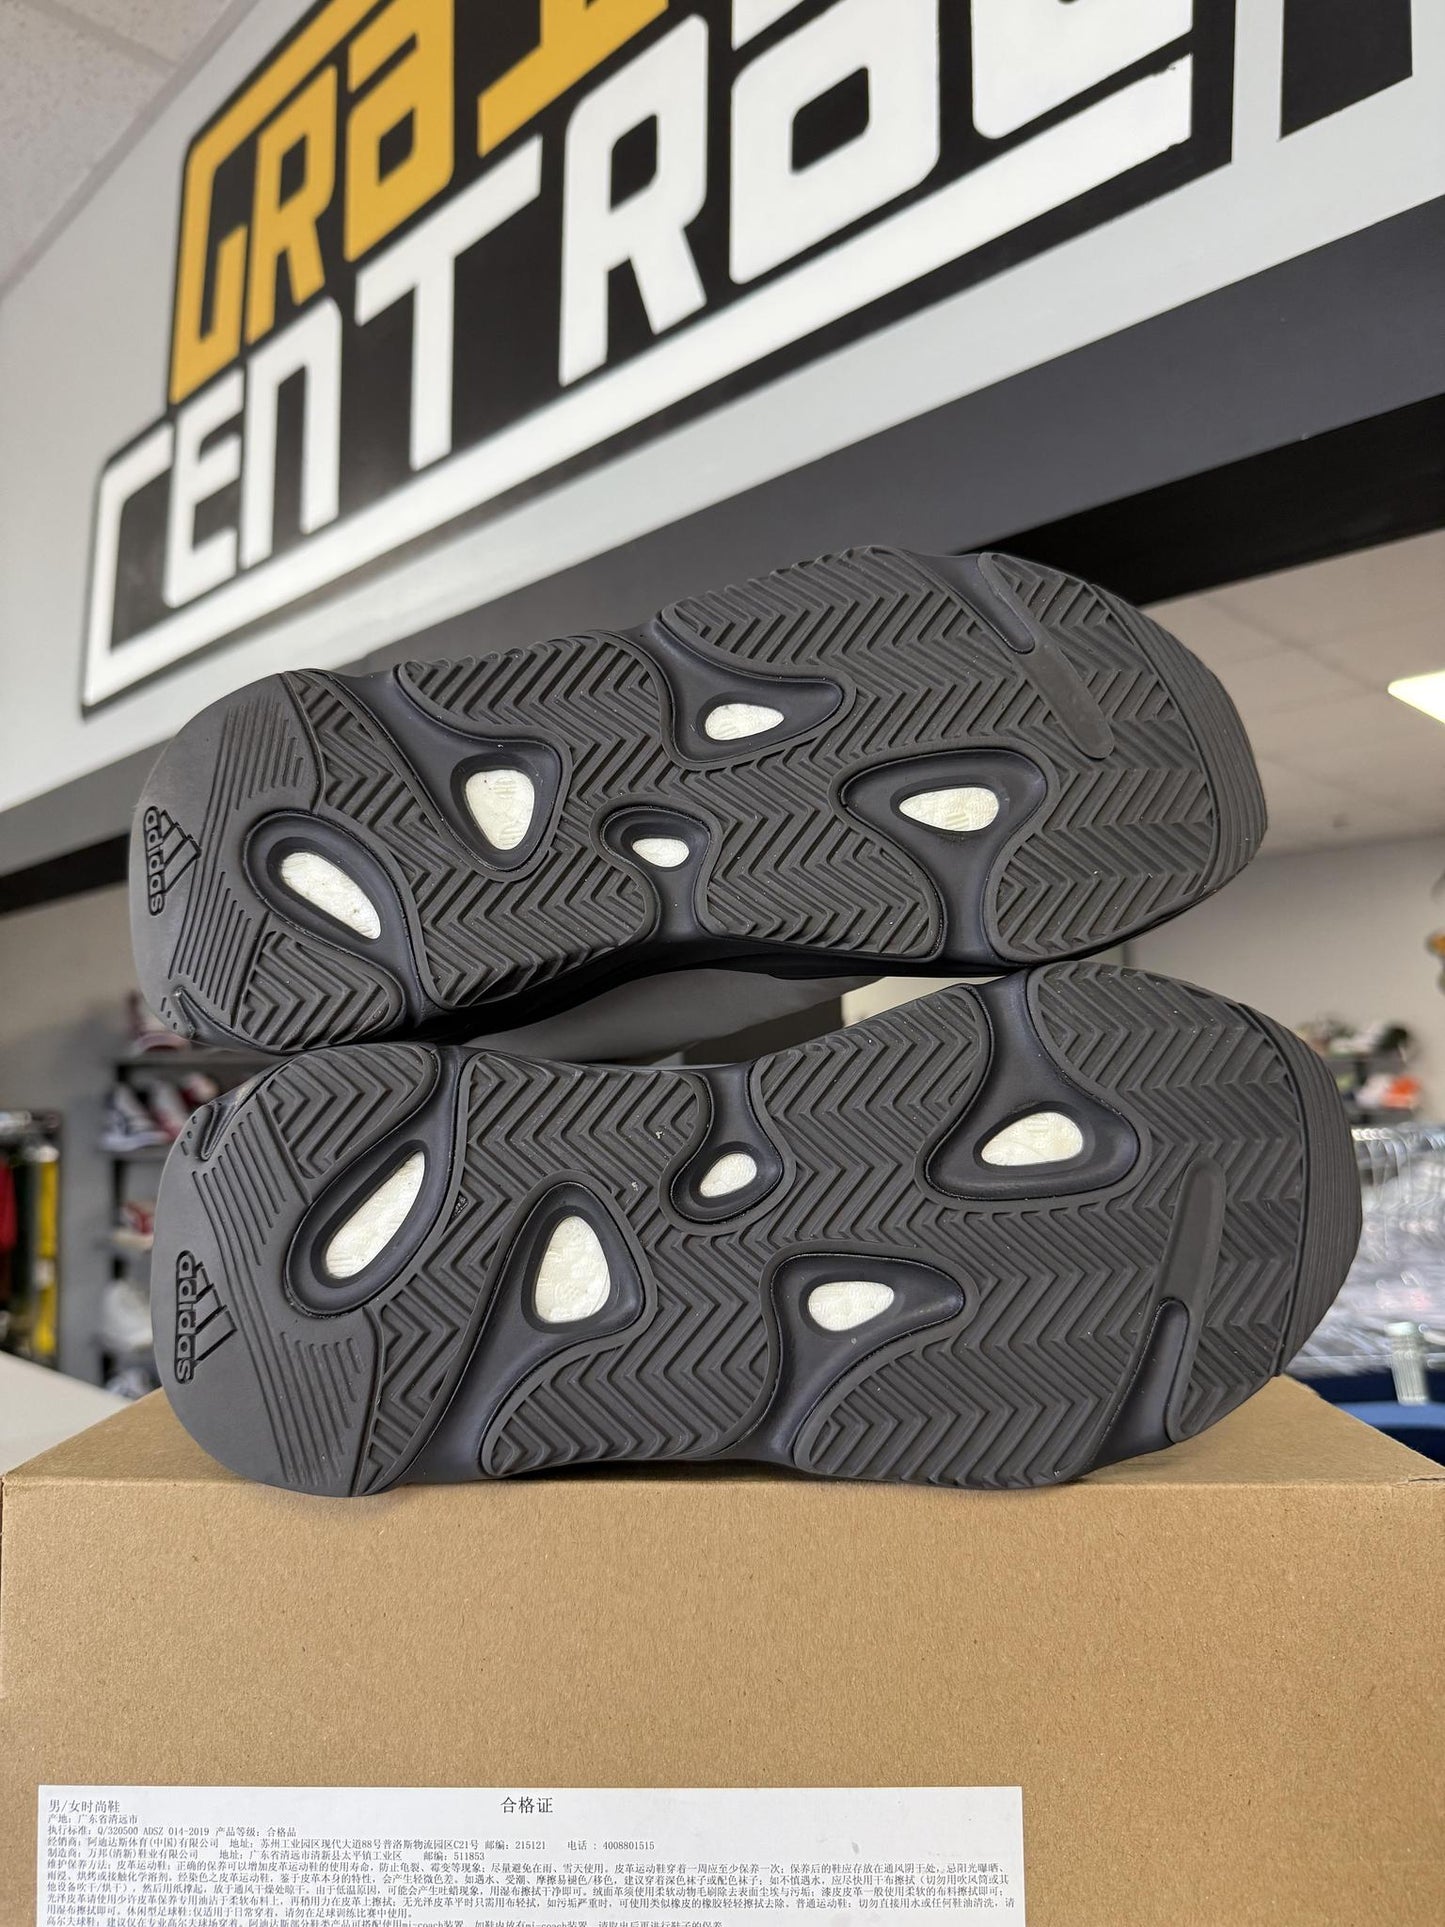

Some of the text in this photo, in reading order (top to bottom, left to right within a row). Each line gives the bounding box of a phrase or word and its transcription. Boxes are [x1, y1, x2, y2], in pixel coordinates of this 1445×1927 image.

[143, 806, 165, 916] adidas
[175, 1250, 198, 1384] adidas
[48, 1799, 120, 1814] 男/女时尚鞋
[500, 1796, 554, 1814] 合格证
[143, 1826, 164, 1836] ADSZ
[168, 1826, 210, 1837] 014-2019
[567, 1840, 588, 1851] 电话
[602, 1841, 655, 1851] 4008801515
